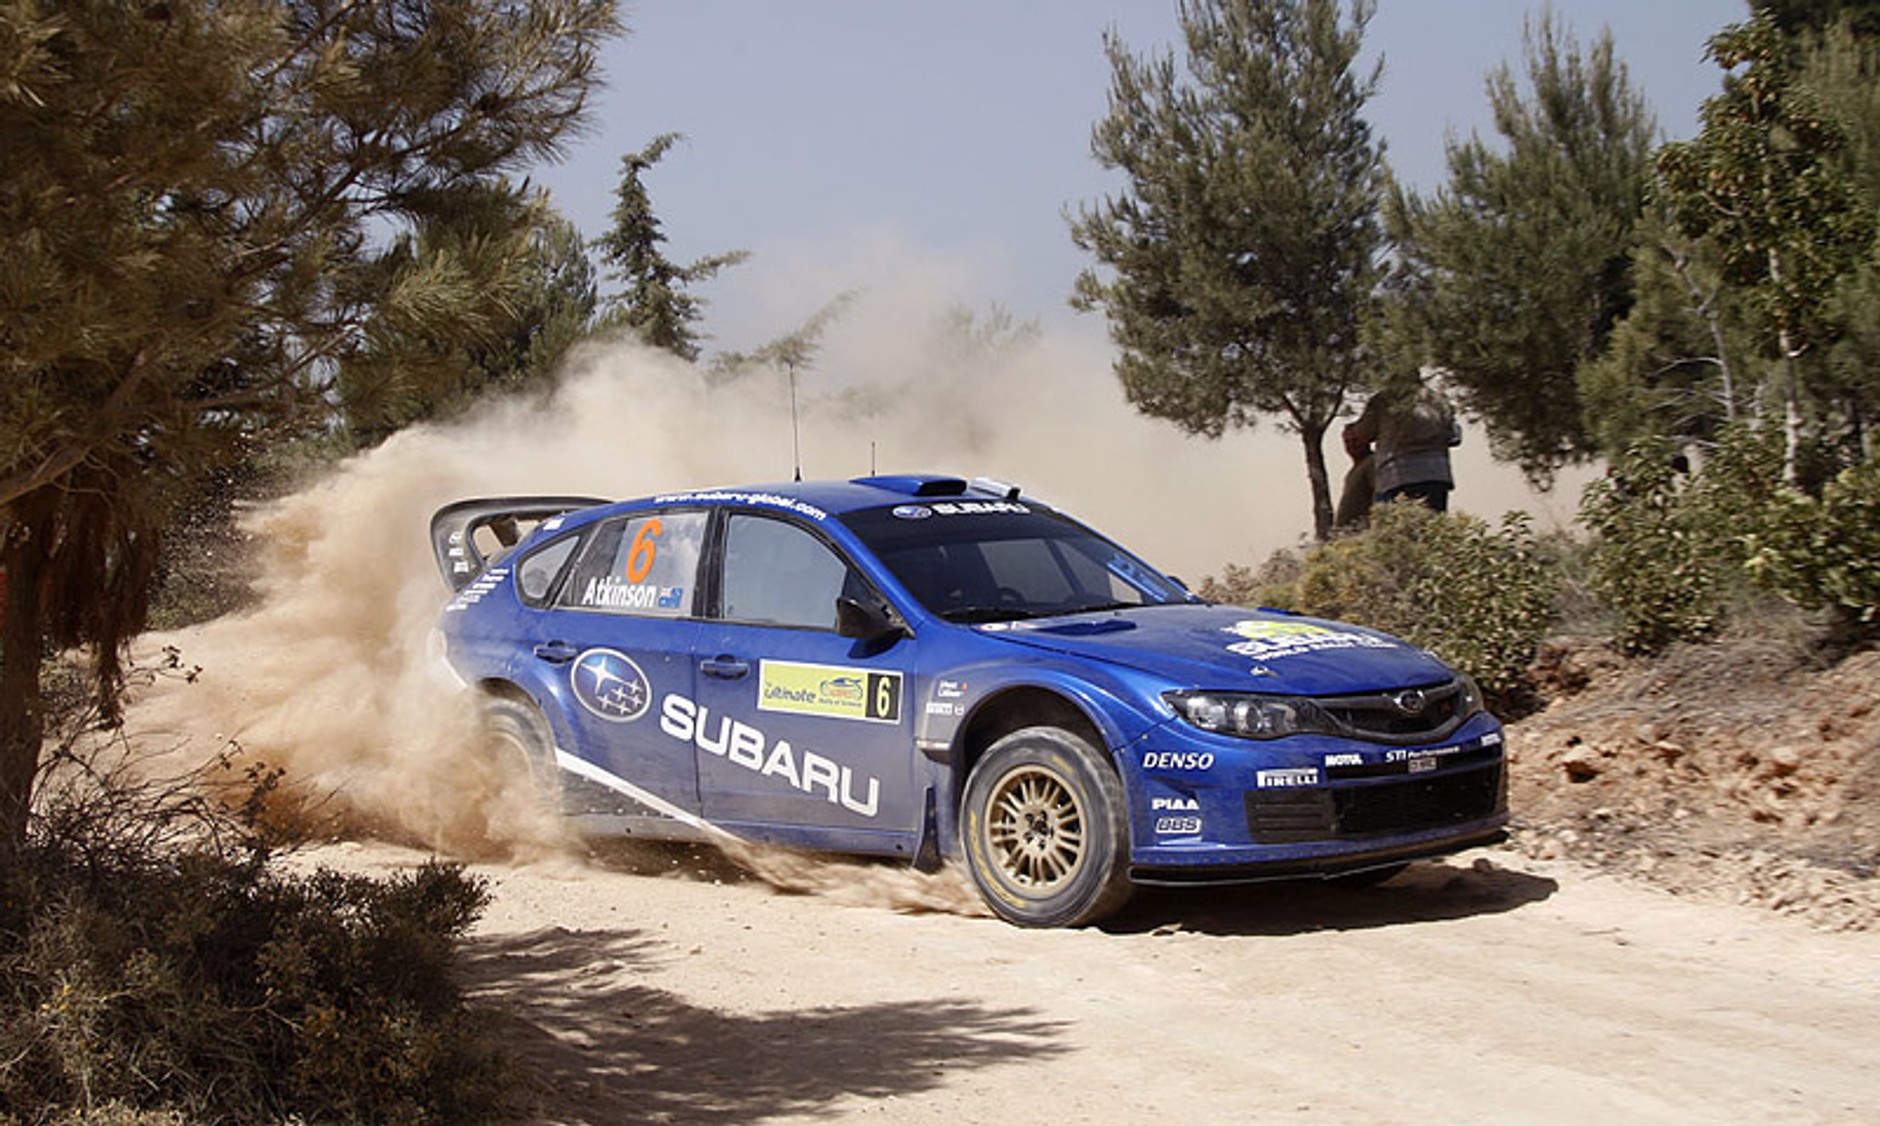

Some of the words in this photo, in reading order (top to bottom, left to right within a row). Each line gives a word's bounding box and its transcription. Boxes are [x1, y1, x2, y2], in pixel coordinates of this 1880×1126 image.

[931, 502, 1031, 515] SUBARU
[626, 517, 663, 584] 6
[581, 574, 658, 608] Atkinson
[876, 676, 891, 718] 6
[660, 693, 880, 817] SUBARU
[1142, 752, 1215, 770] DENSO
[1325, 753, 1363, 767] MOTUL
[1256, 767, 1318, 788] PIRELLI
[1151, 798, 1200, 811] PIAA
[1156, 817, 1202, 832] BBS
